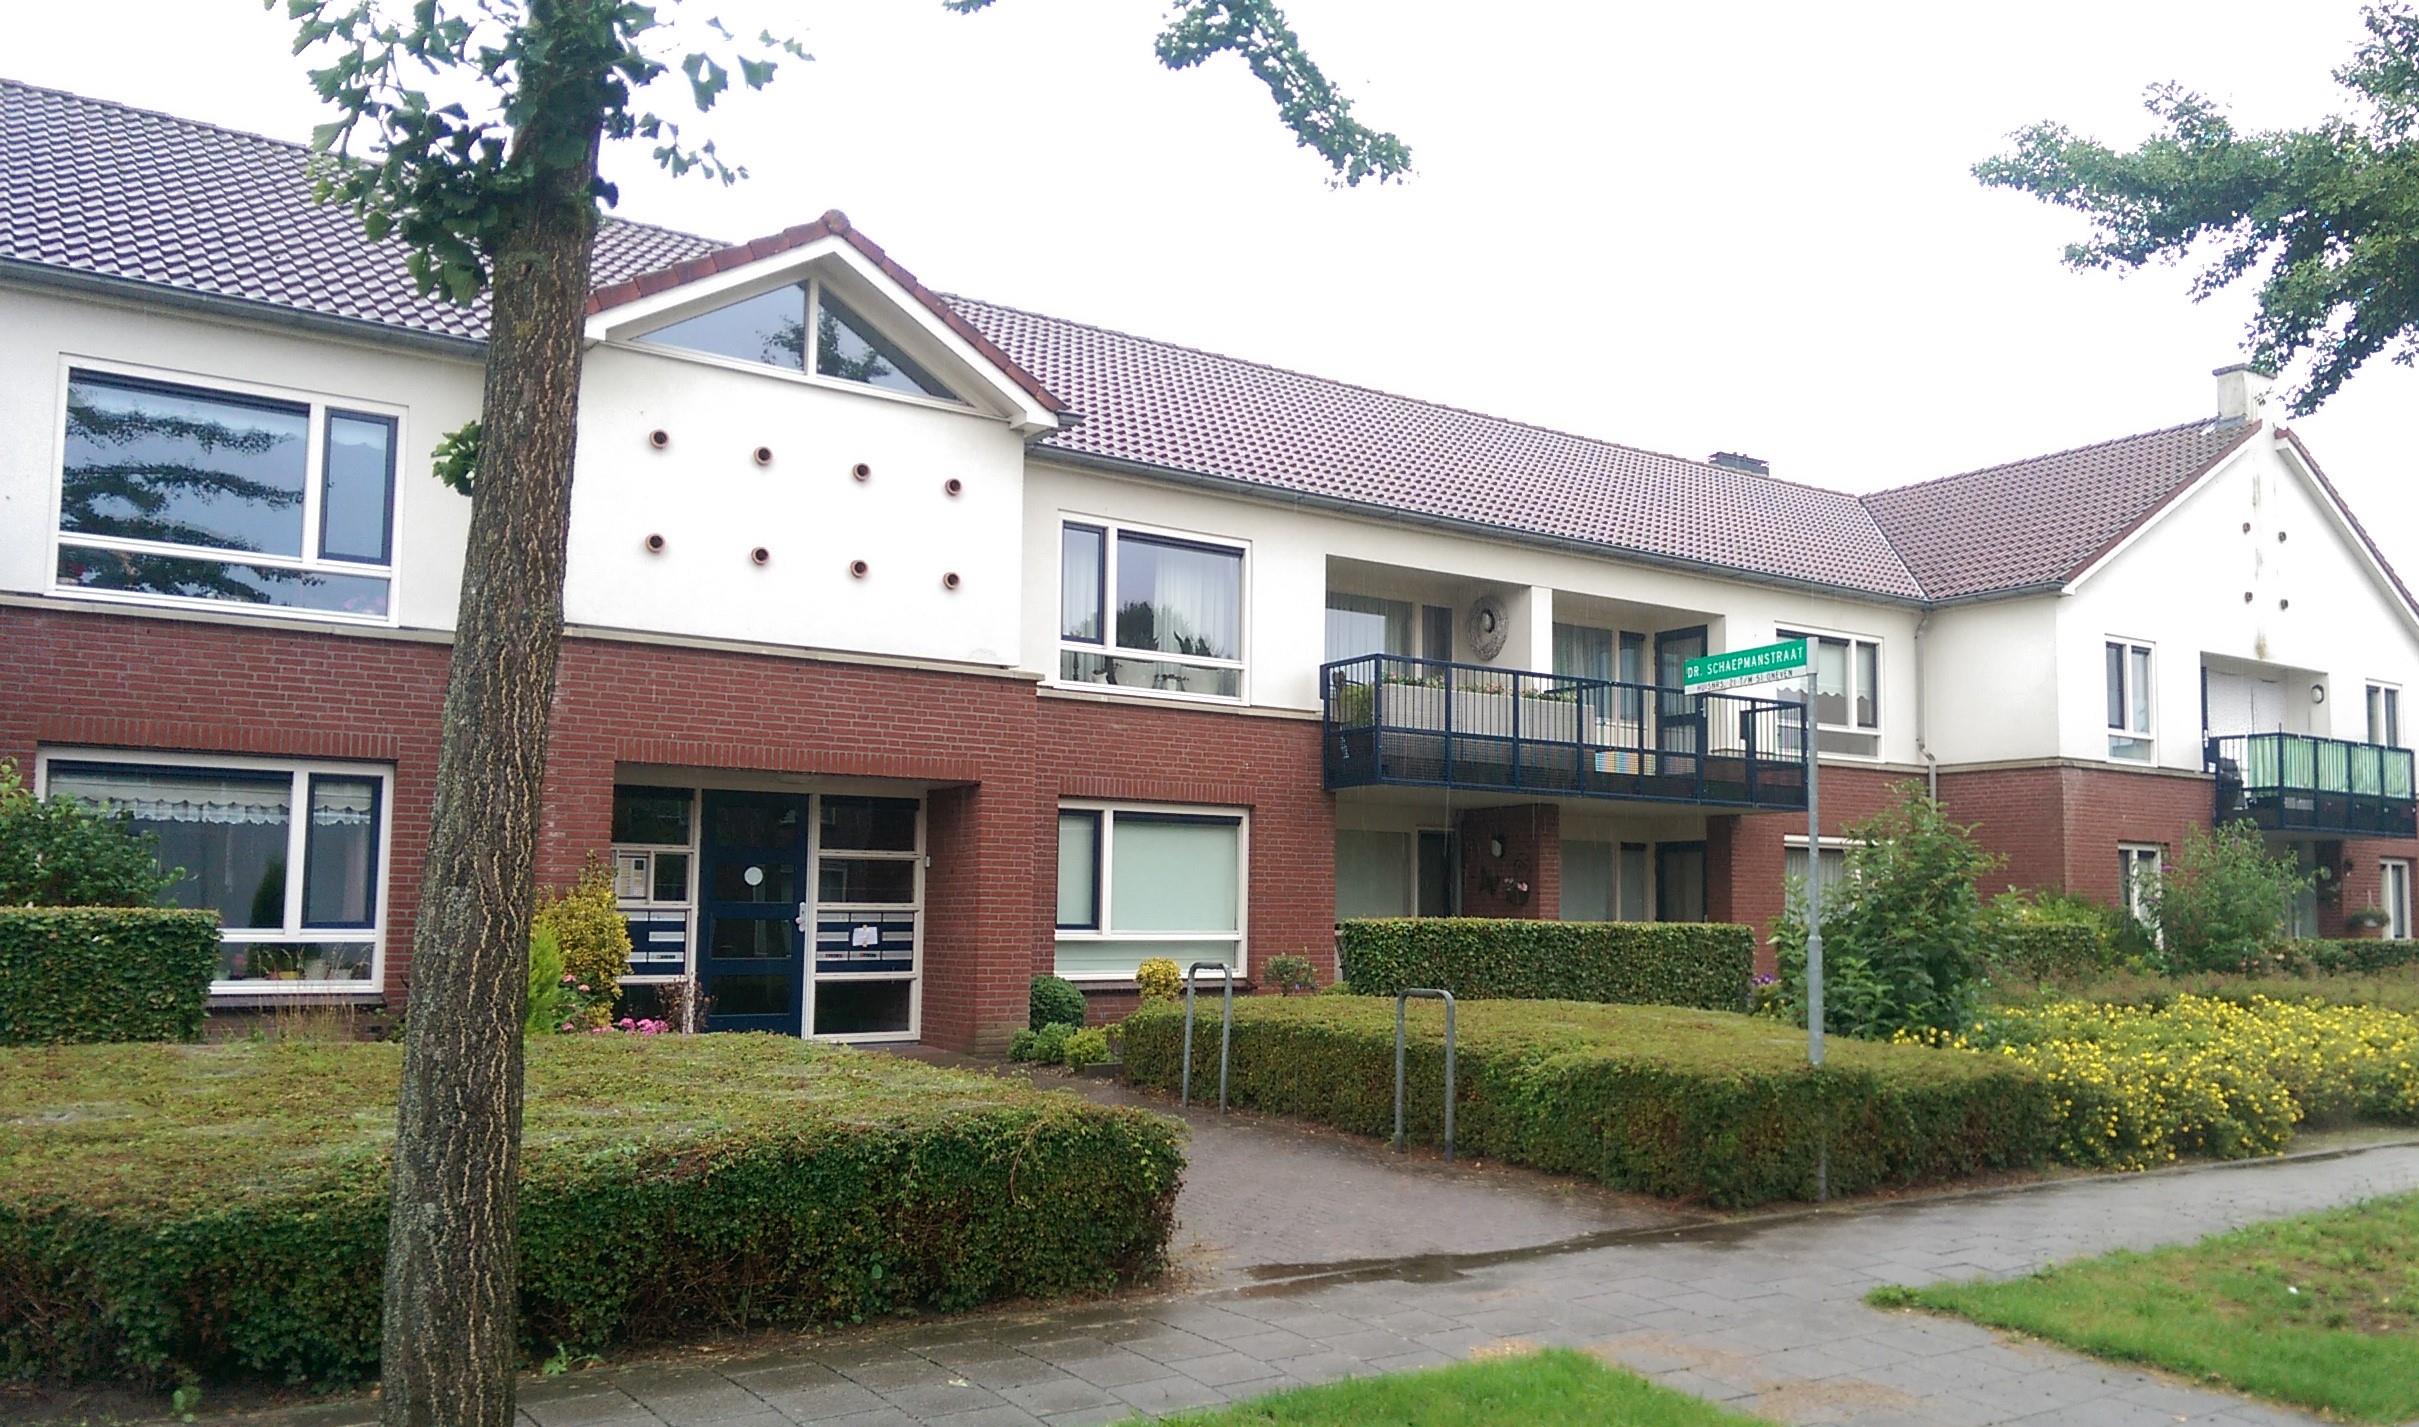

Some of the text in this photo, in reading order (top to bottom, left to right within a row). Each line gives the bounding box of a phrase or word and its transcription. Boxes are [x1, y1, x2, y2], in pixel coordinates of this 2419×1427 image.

[1687, 647, 1803, 679] DR. SCHAEPMANSTRAAT
[1767, 670, 1793, 681] ONEVEN
